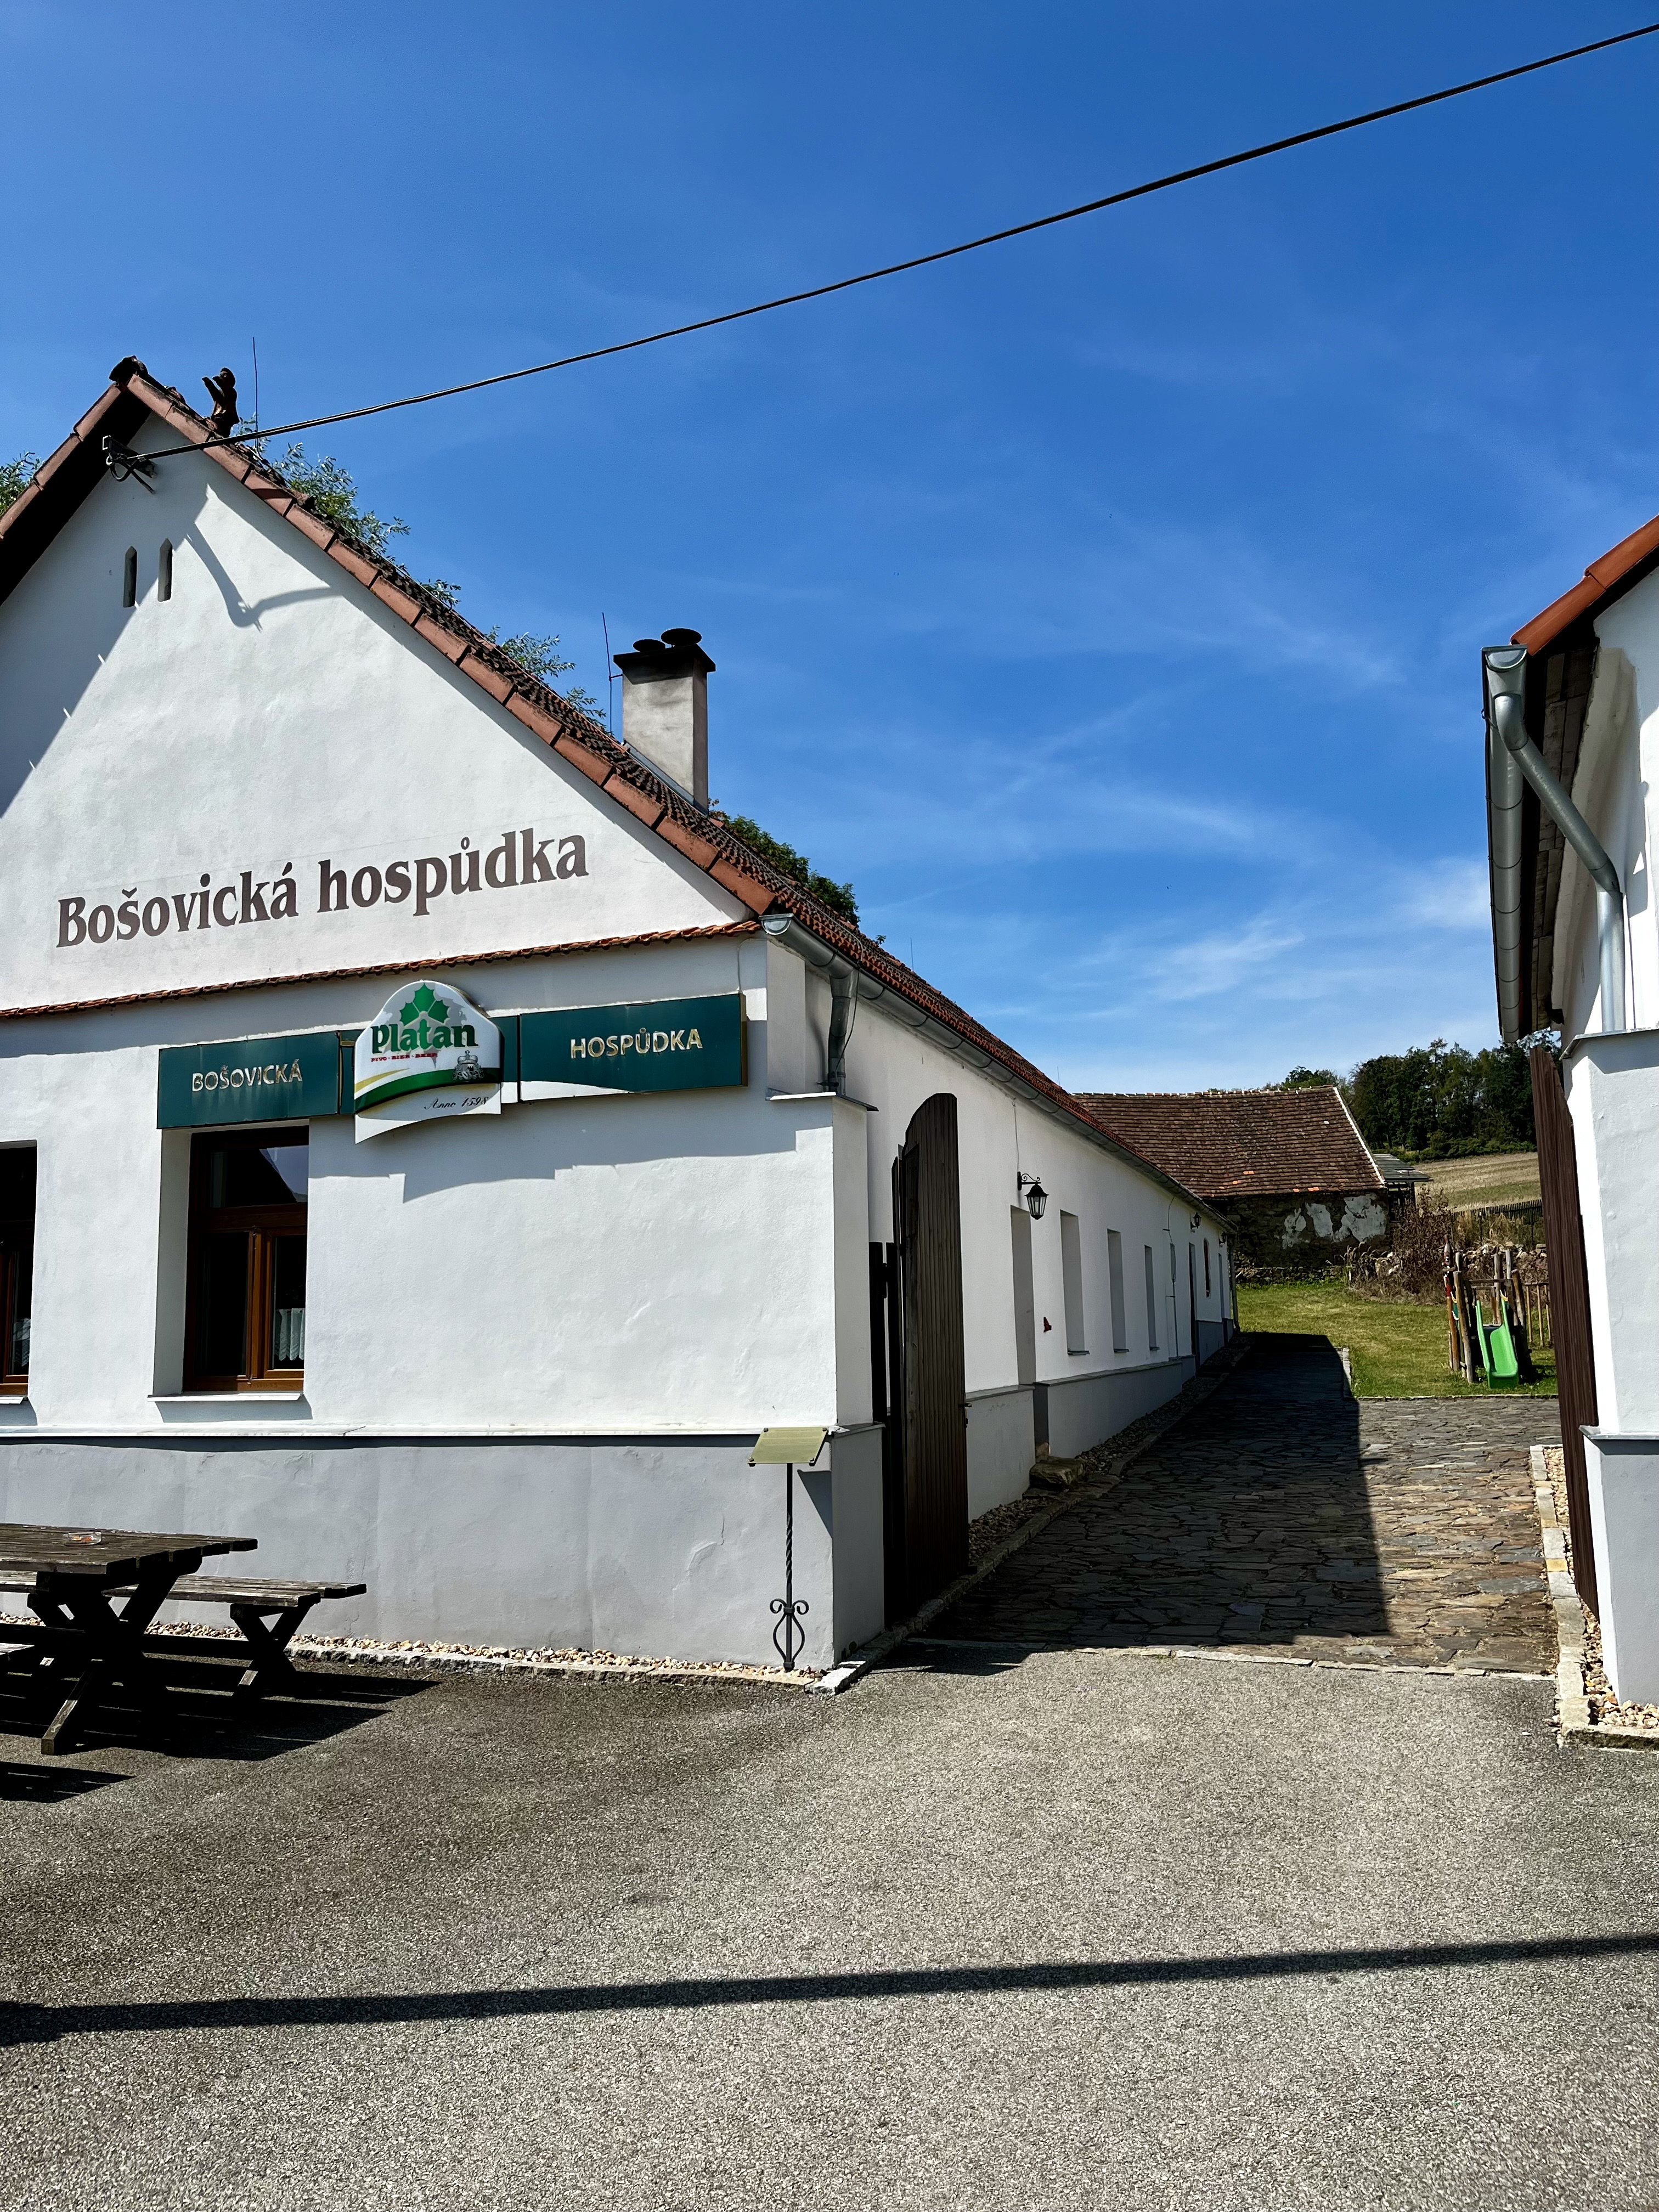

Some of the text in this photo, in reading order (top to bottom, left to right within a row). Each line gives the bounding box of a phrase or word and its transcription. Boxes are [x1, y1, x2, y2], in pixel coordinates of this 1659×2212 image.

[57, 828, 589, 948] Bošovická hospůdka
[571, 1027, 703, 1059] HOSPŮDKA
[192, 1058, 302, 1092] BOŠOVICKÁ
[424, 1097, 489, 1109] Anno 1598
